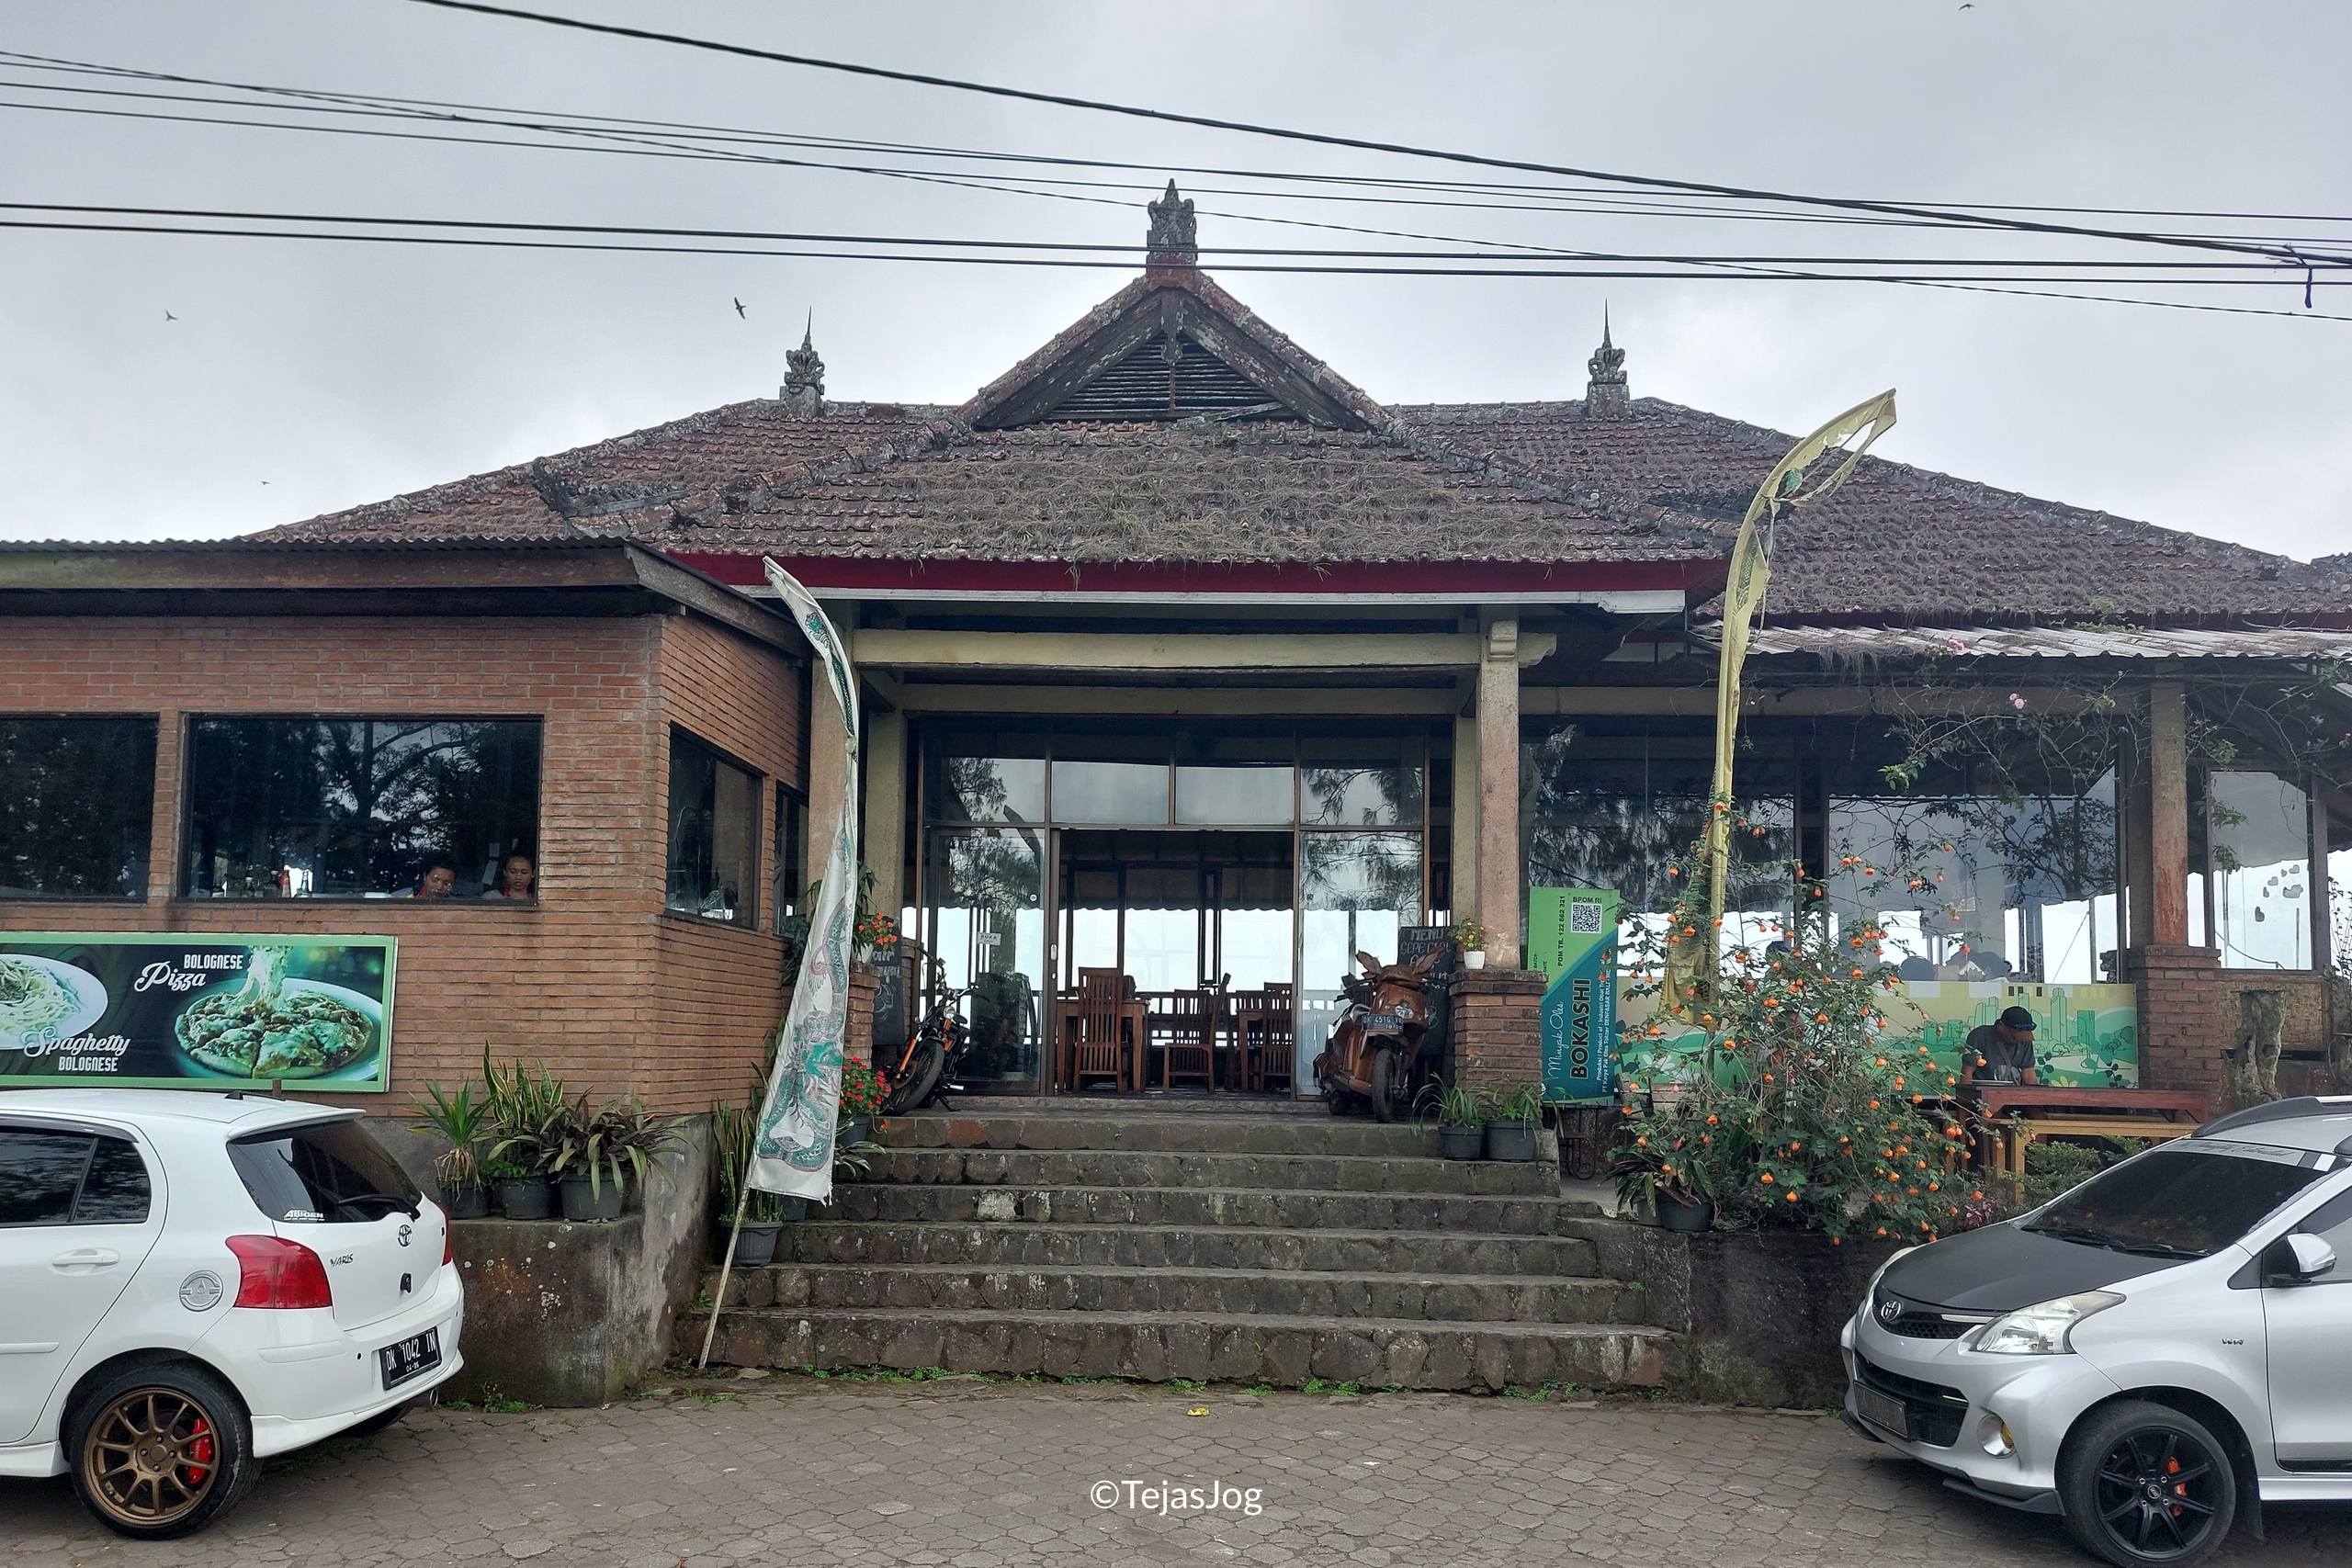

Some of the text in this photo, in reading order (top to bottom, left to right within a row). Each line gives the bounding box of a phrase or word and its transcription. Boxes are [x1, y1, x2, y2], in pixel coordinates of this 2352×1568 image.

[1410, 928, 1444, 941] MENU
[133, 961, 207, 992] Pizza
[184, 953, 244, 970] BOLOGNESE
[20, 1026, 131, 1057] Spaghetty
[1547, 1001, 1569, 1077] Minyak Oles
[1570, 978, 1590, 1078] BOKASHI
[58, 1055, 119, 1072] BOLOGNESE
[330, 1253, 355, 1268] YARIS
[386, 1348, 397, 1371] DK
[401, 1338, 421, 1364] 1042
